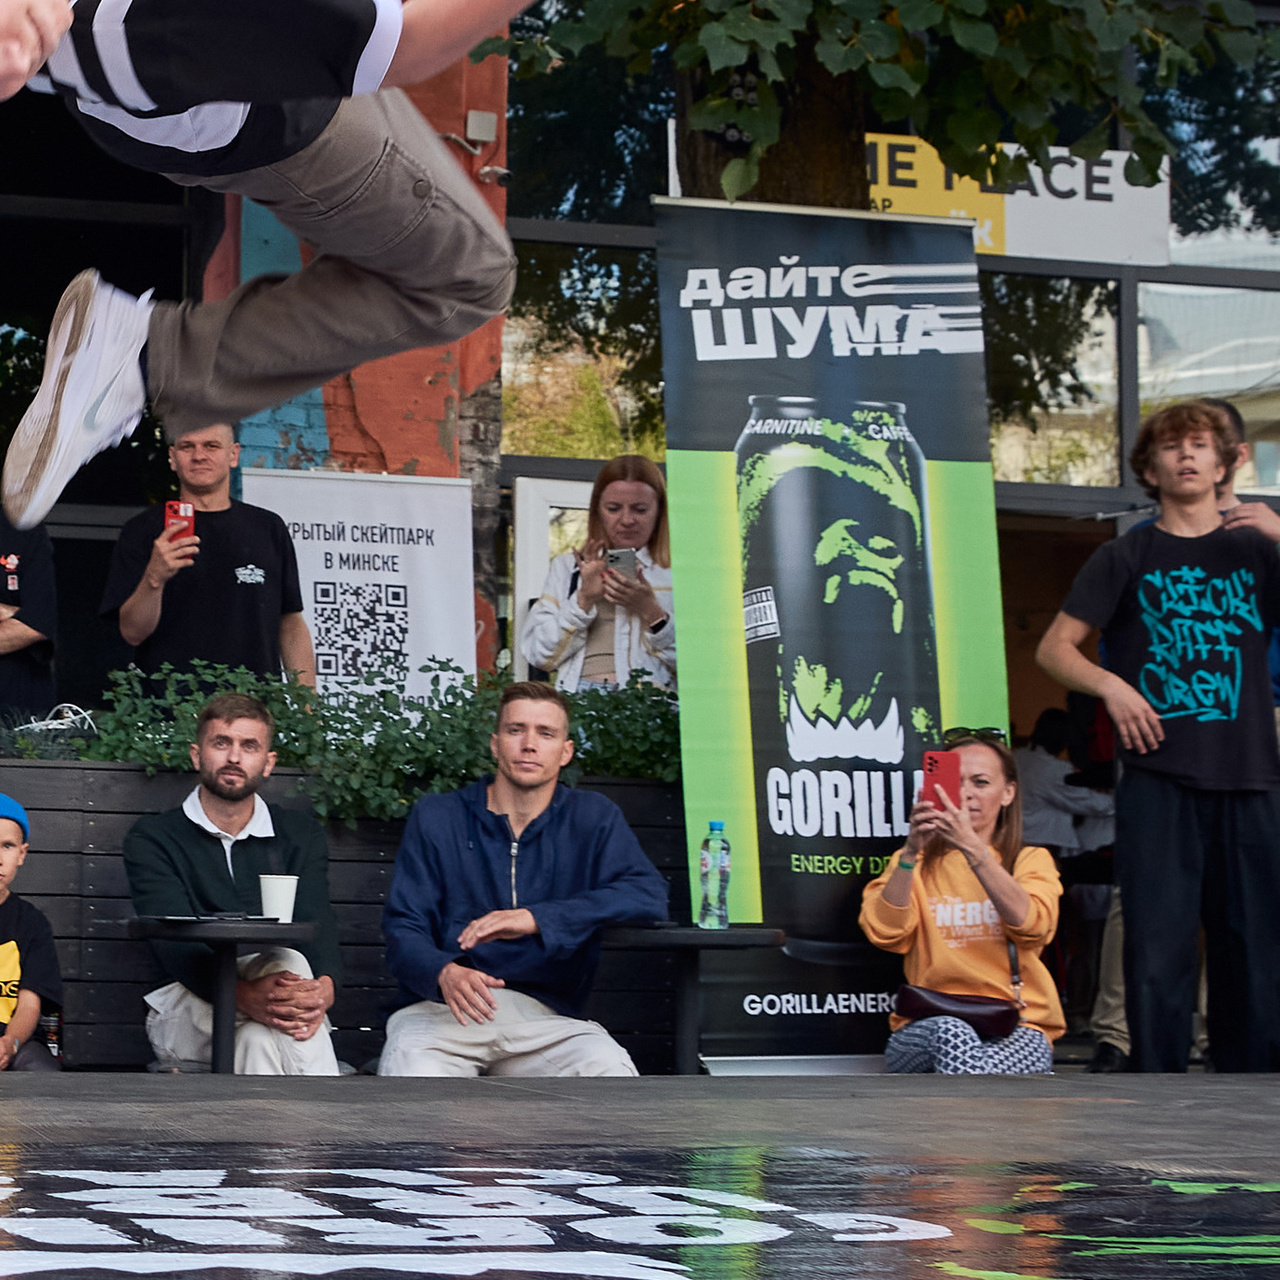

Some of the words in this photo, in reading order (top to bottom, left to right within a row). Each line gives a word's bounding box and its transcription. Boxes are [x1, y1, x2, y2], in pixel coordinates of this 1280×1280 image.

[680, 256, 977, 307] дайте
[691, 304, 984, 361] ШУМА
[351, 523, 435, 546] СКЕЙТПАРК
[324, 551, 333, 569] В
[339, 552, 399, 572] МИНСКЕ
[791, 854, 863, 874] ENERGY
